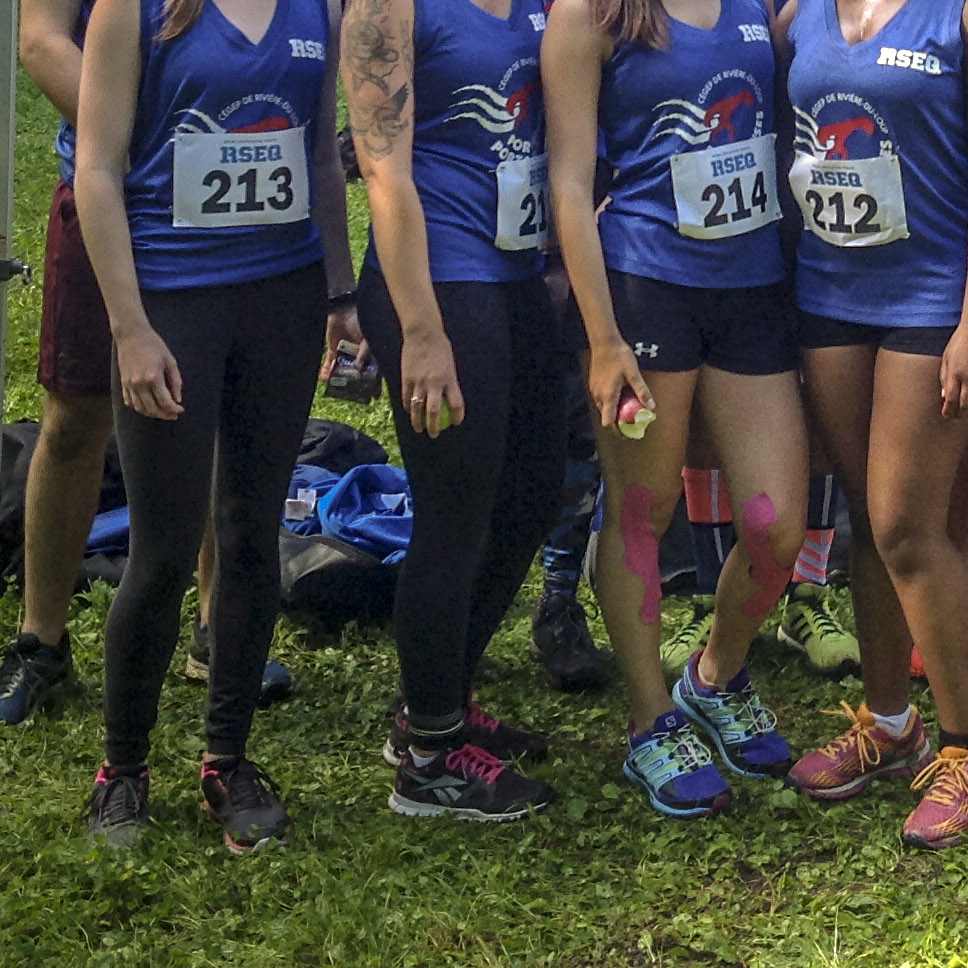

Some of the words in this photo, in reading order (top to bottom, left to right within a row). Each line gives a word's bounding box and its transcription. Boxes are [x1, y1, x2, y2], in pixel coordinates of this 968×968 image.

[289, 38, 325, 61] RSE
[877, 47, 942, 75] RSEQ
[220, 145, 282, 164] RSEQ
[711, 152, 757, 177] RSEQ
[201, 166, 294, 214] 213
[811, 170, 863, 188] RSEQ
[519, 188, 546, 237] 21
[702, 171, 768, 229] 214
[805, 190, 882, 233] 212
